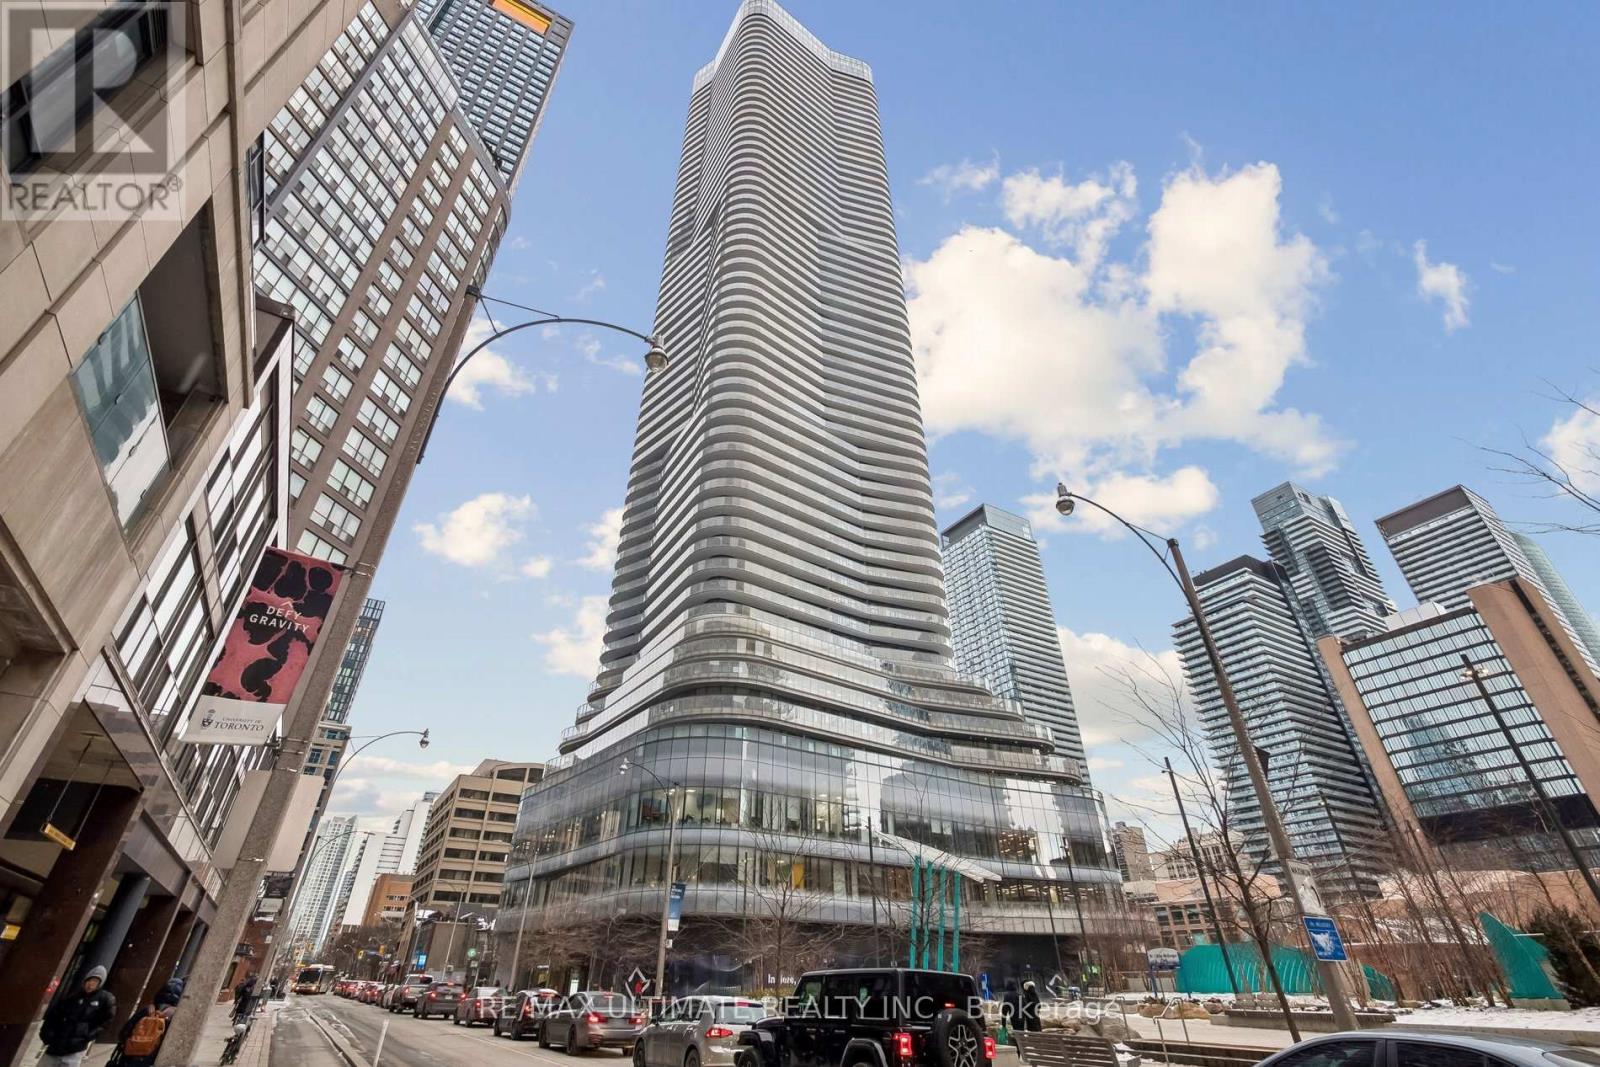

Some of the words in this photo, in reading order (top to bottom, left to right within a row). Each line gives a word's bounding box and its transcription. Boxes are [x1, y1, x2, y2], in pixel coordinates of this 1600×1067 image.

[266, 606, 302, 620] DEFY
[249, 614, 309, 633] GRAVITY
[214, 721, 264, 731] TORONTO
